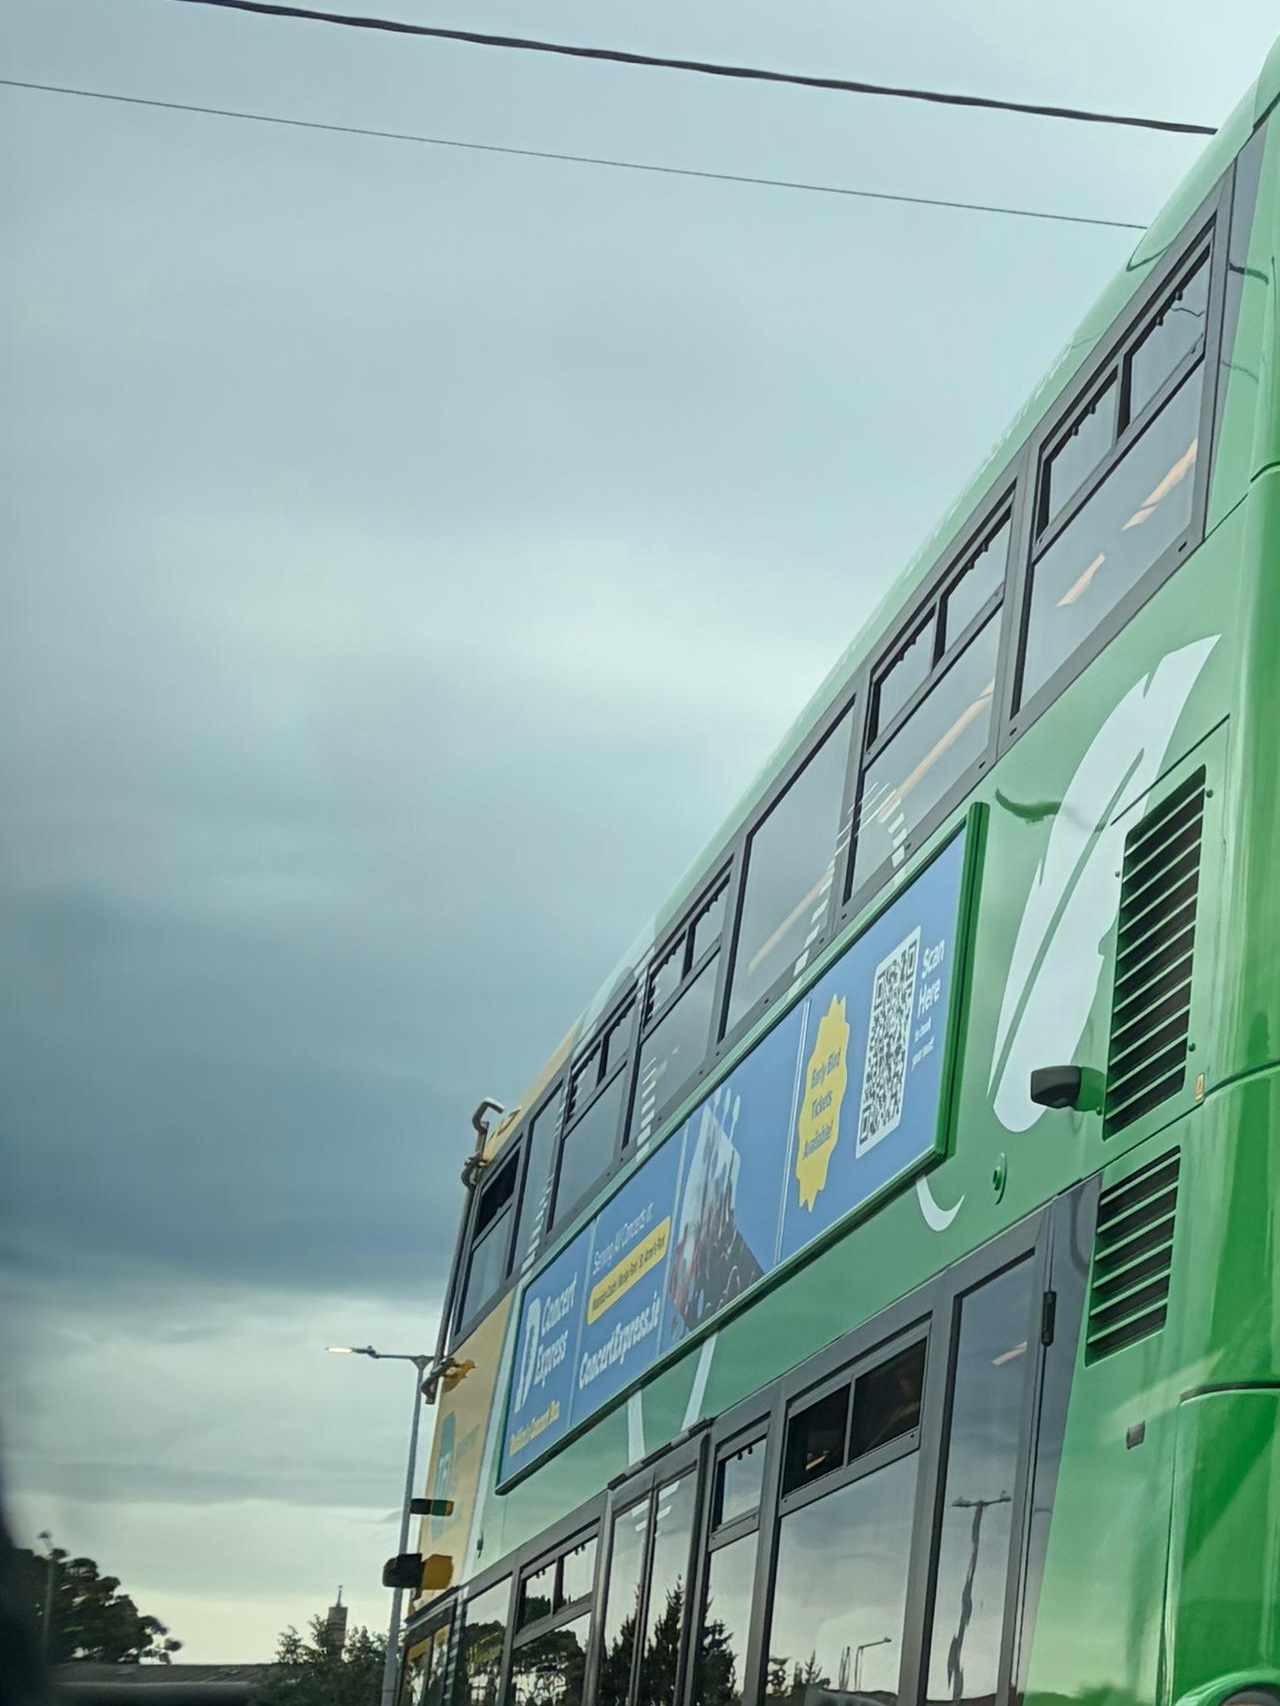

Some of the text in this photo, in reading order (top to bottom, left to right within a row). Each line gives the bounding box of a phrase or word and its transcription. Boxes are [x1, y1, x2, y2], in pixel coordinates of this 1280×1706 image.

[922, 939, 945, 979] Scan
[917, 978, 941, 1017] Here
[541, 1273, 577, 1336] Concert
[534, 1329, 569, 1388] Express
[578, 1291, 661, 1390] ConcertExpress.ie
